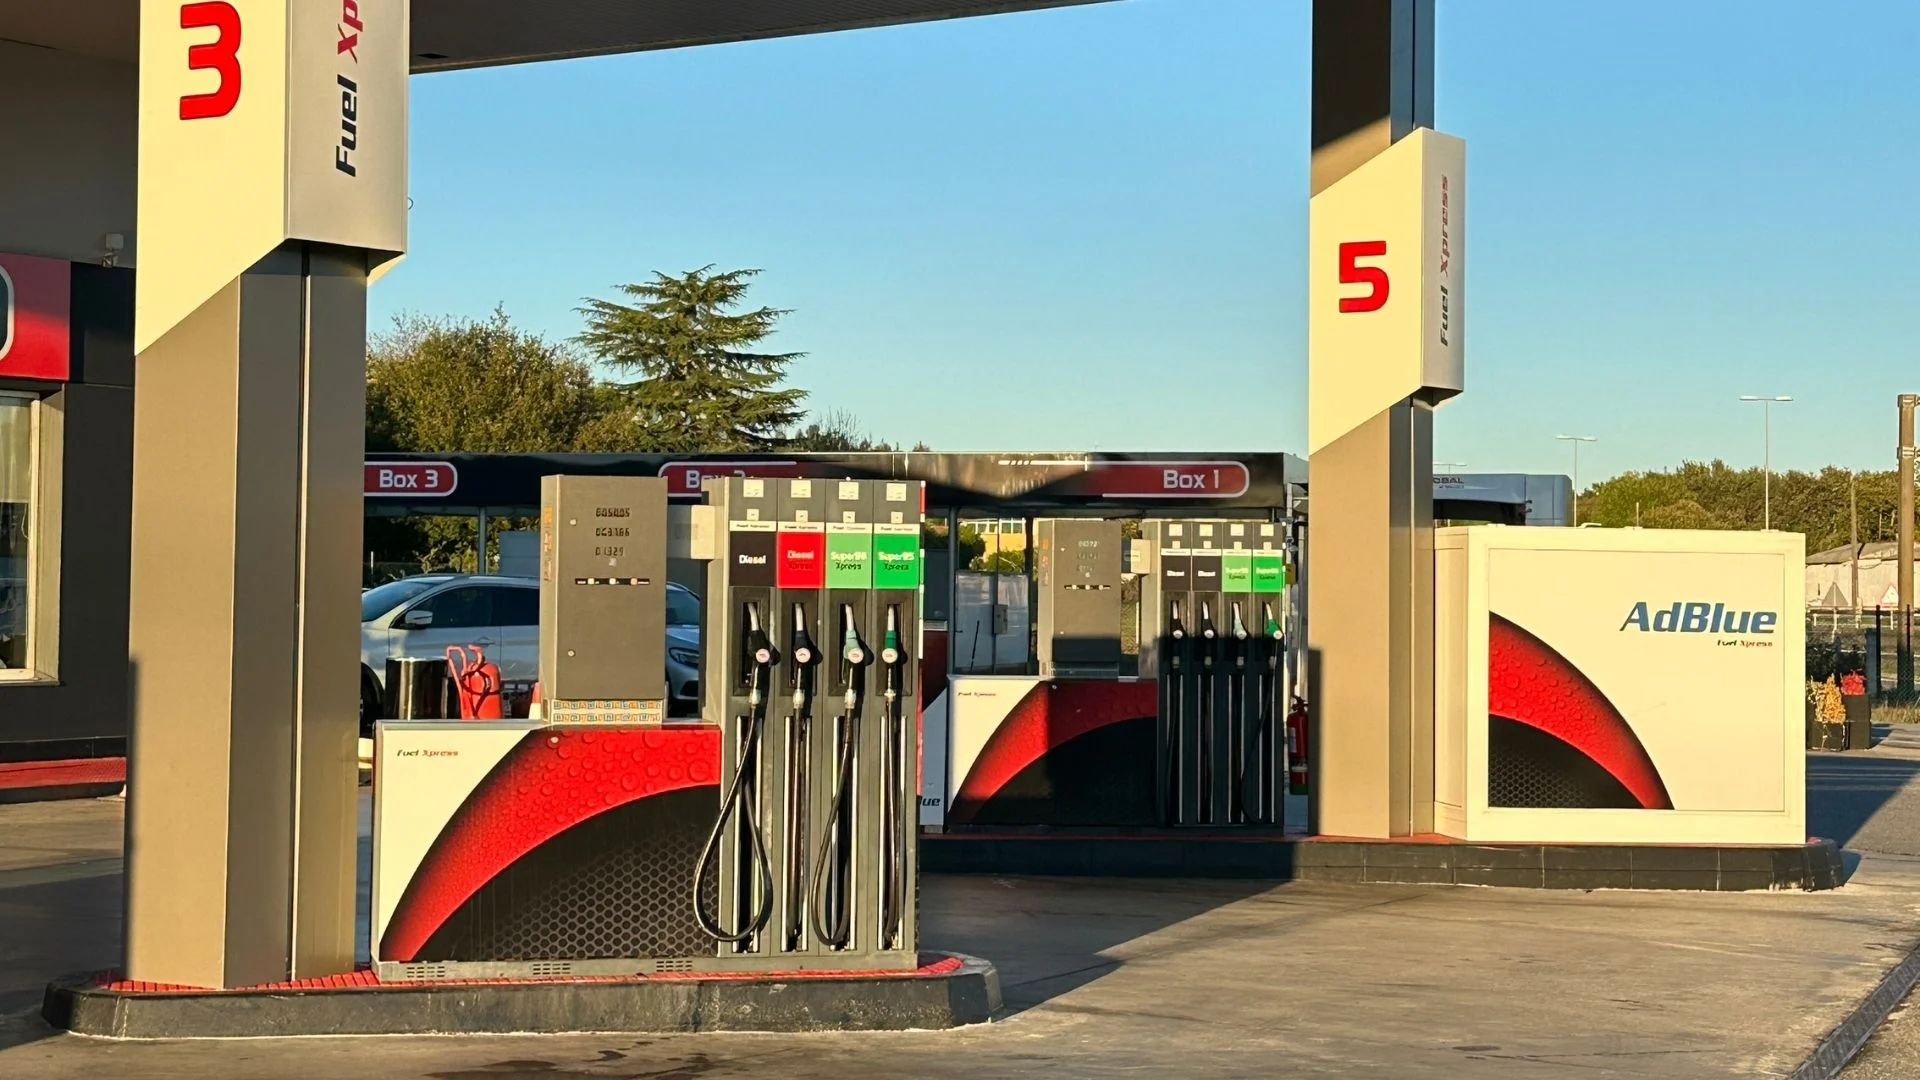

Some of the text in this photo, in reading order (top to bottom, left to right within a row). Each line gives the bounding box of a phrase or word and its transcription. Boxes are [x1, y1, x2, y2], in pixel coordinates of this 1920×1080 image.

[179, 1, 242, 120] 3
[335, 73, 358, 178] Fuel
[1338, 240, 1390, 314] 5
[1440, 285, 1450, 347] Fuel
[379, 469, 439, 488] Box 3
[1163, 469, 1220, 489] Box 1
[738, 553, 767, 565] Diesel
[786, 549, 815, 560] Diesel
[1619, 601, 1778, 634] AdBlue
